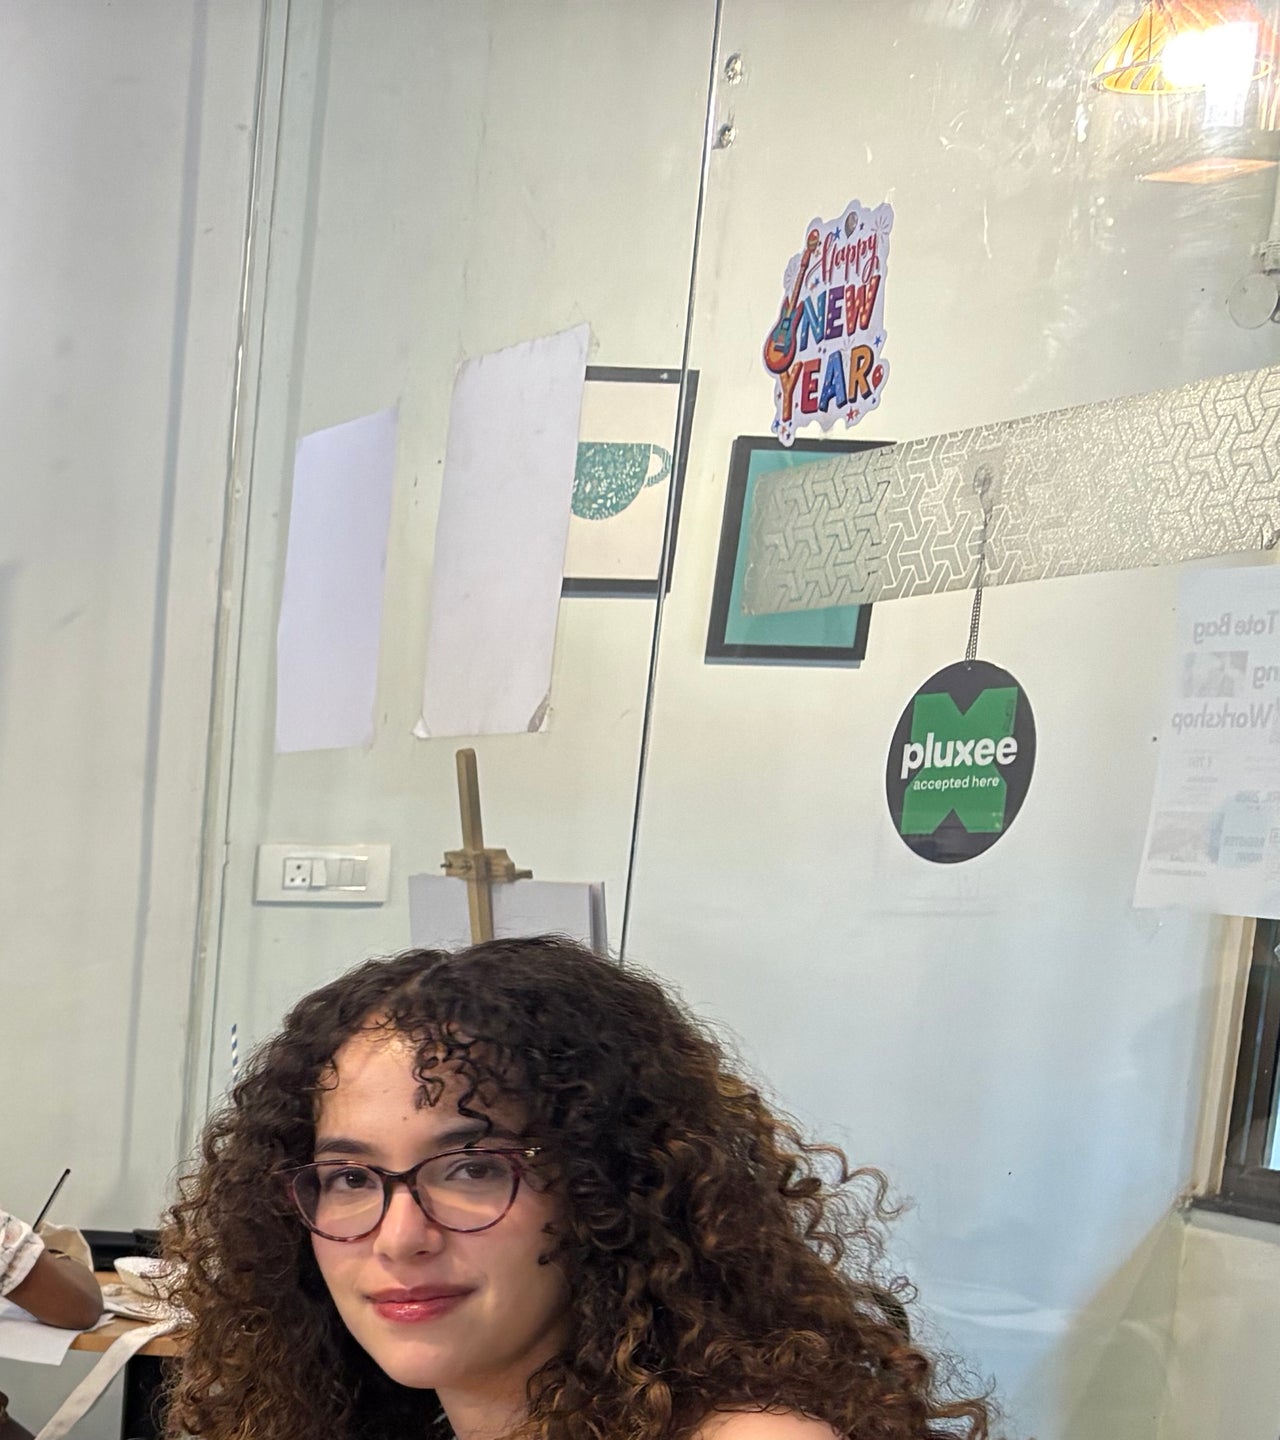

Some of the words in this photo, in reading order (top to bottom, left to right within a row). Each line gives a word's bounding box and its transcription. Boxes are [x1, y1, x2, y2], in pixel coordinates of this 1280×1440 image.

[805, 231, 880, 286] Happy
[799, 274, 881, 352] NEW
[779, 344, 875, 423] YEAR
[900, 732, 1018, 780] pluxee
[913, 776, 969, 791] accepted
[971, 775, 1000, 787] here
